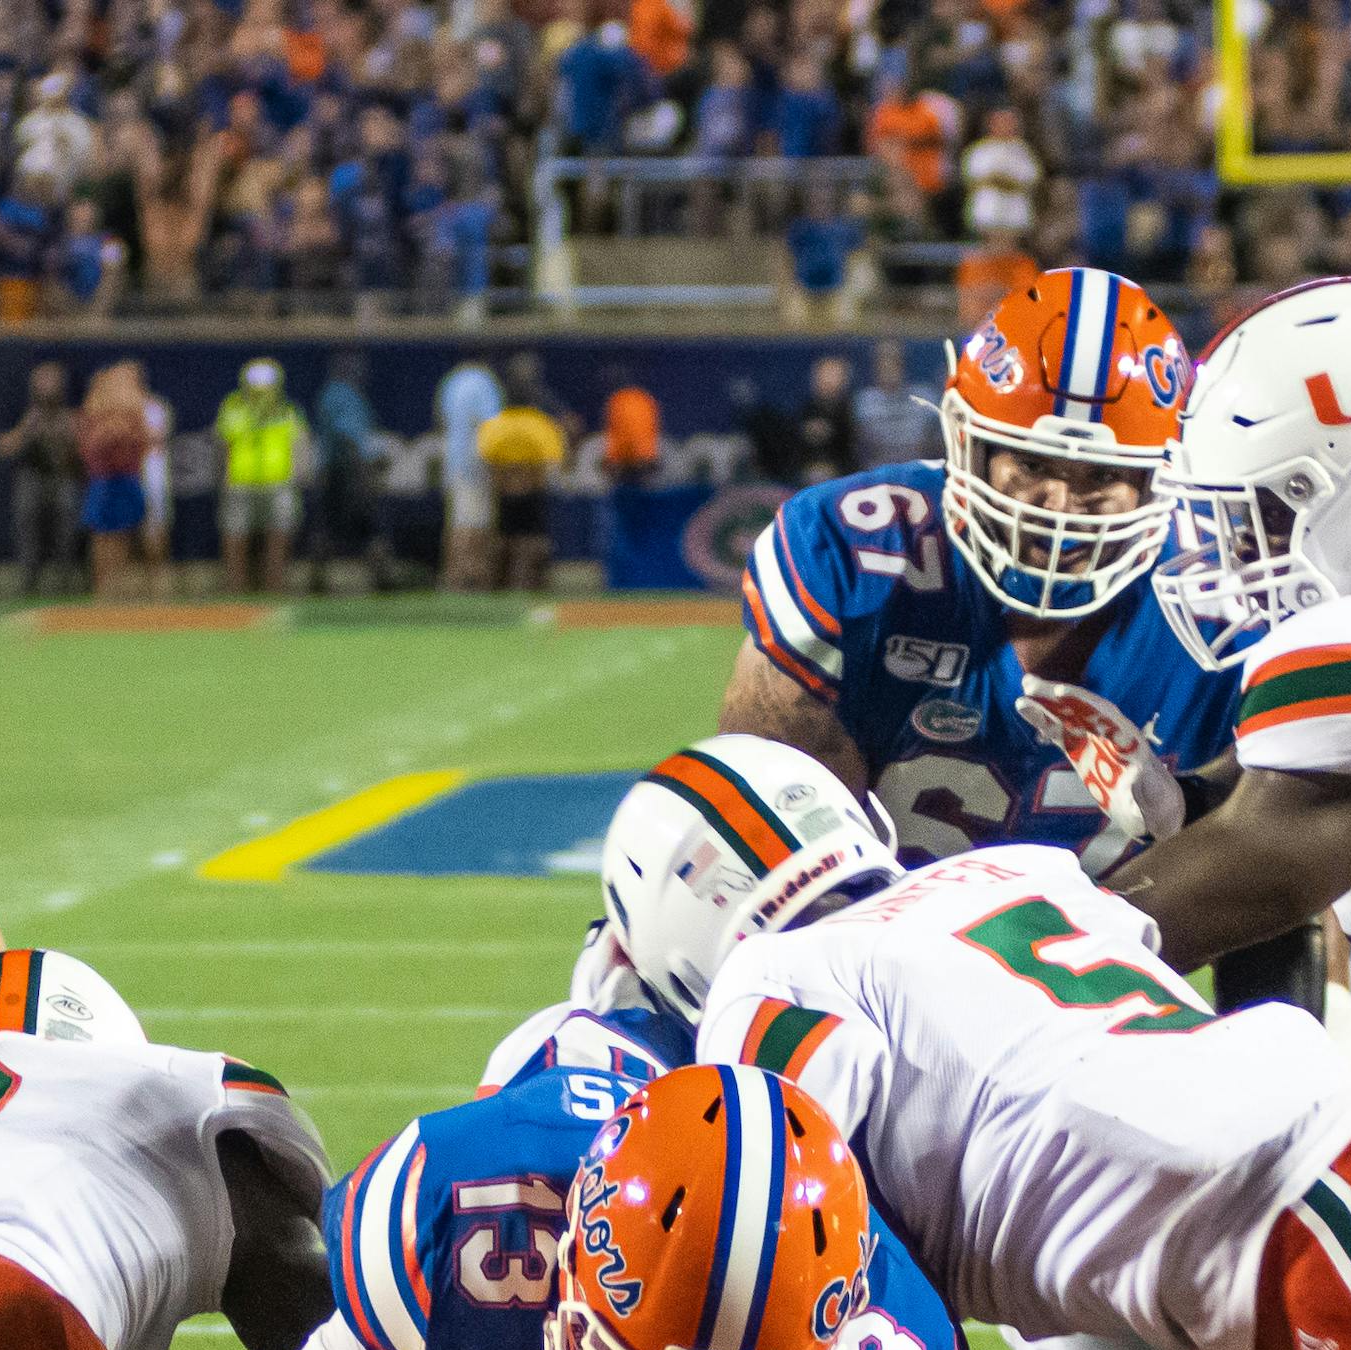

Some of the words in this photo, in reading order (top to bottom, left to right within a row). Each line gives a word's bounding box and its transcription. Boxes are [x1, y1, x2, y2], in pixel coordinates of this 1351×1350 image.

[836, 480, 948, 596] 67
[952, 895, 1218, 1035] 5
[452, 1172, 566, 1309] 13
